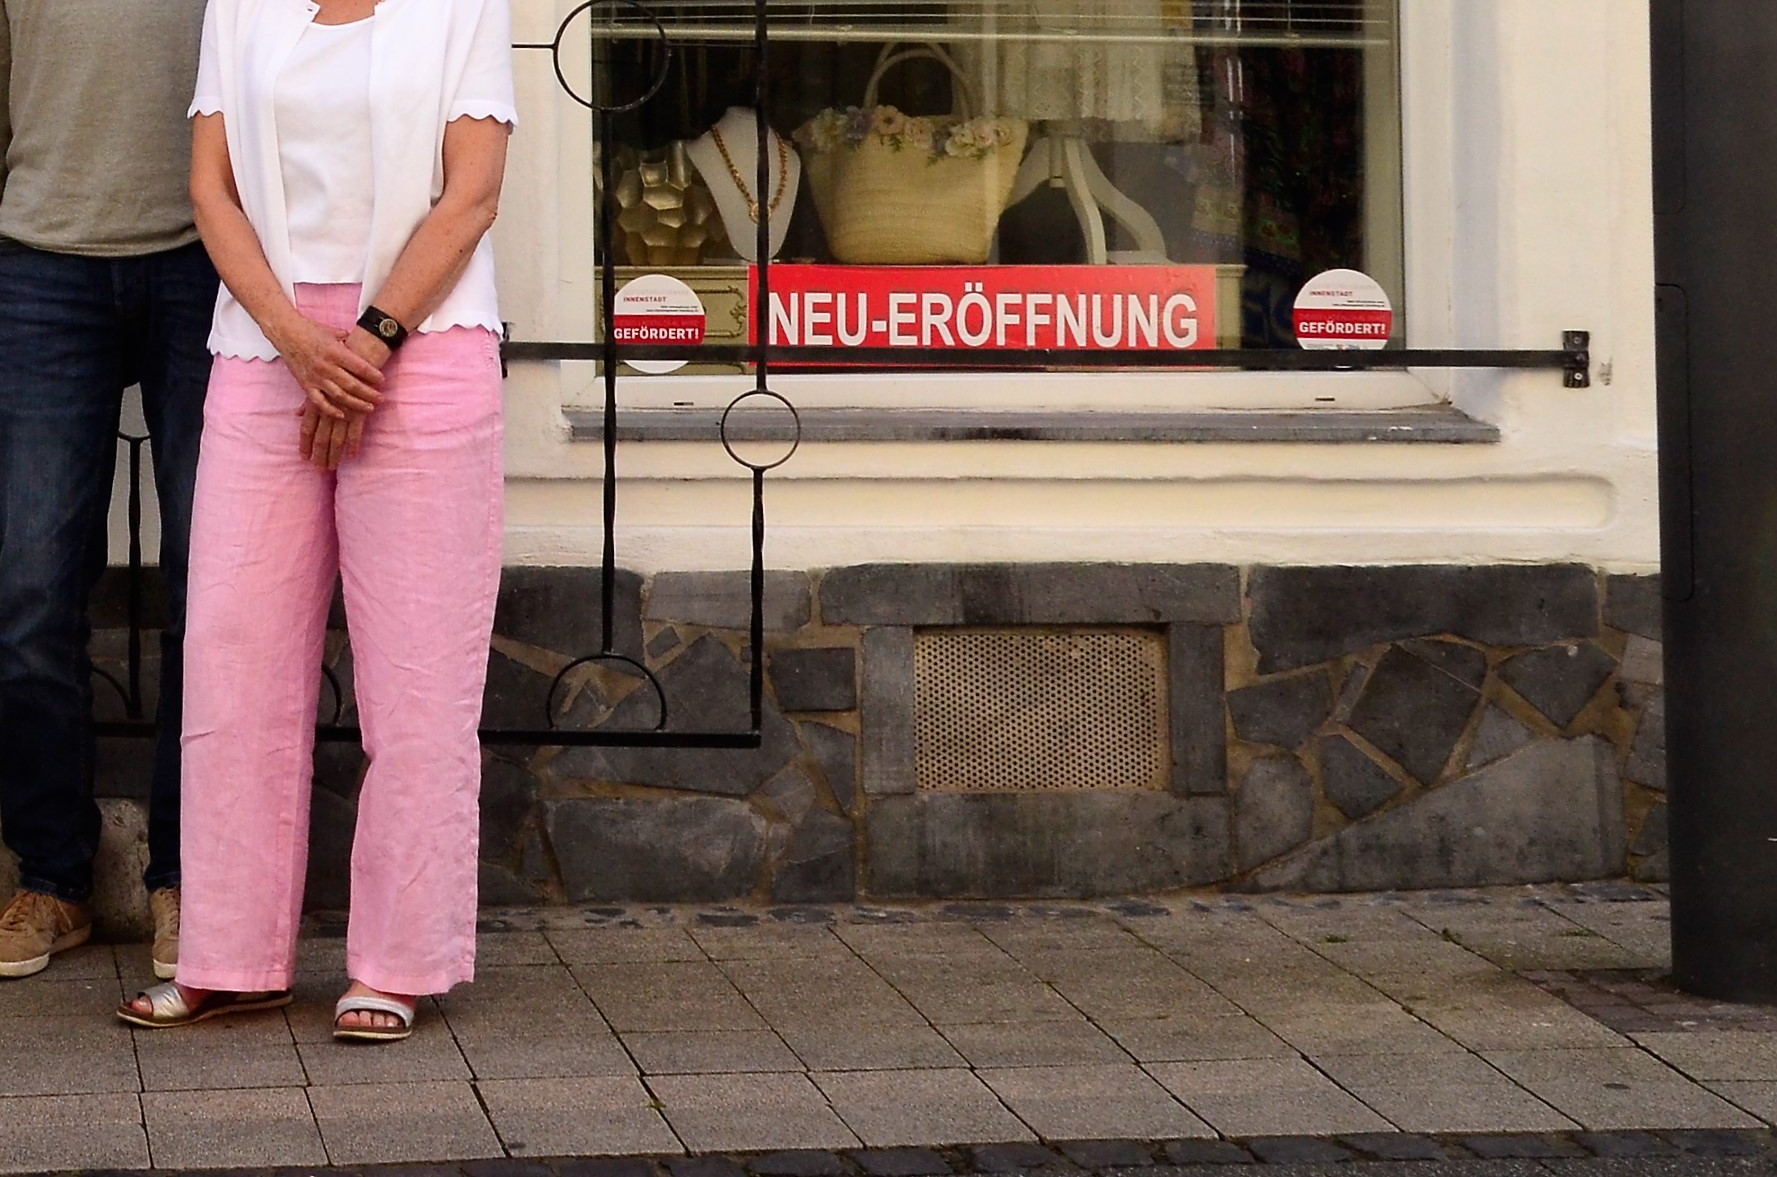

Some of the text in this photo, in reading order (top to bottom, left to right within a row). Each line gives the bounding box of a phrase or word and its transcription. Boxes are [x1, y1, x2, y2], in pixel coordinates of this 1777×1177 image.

[768, 282, 1198, 348] NEU-ERÖFFNUNG
[614, 326, 699, 340] GEFÖRDERT!
[1299, 320, 1386, 335] GEFÖRDERT!
